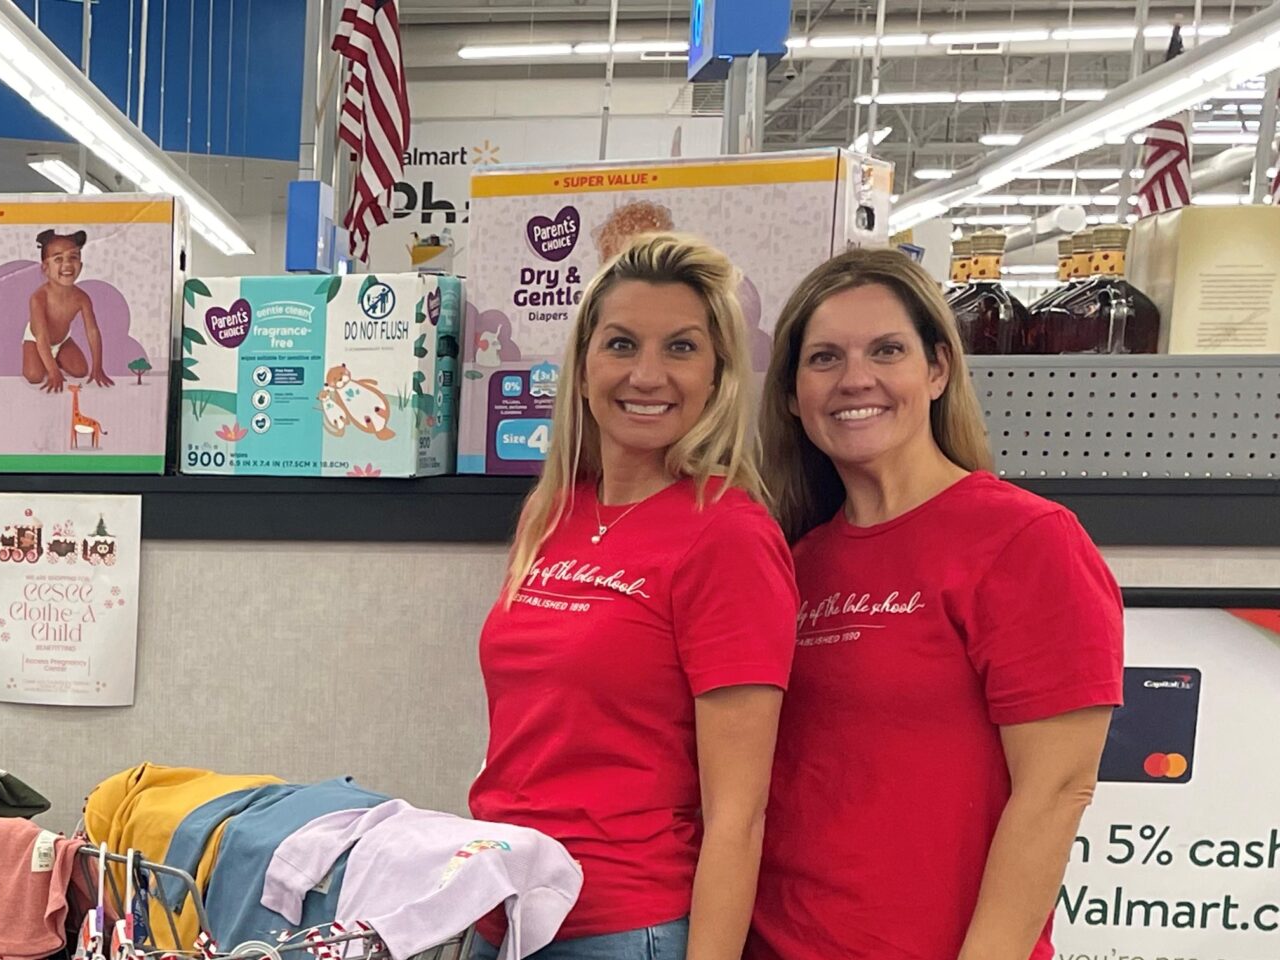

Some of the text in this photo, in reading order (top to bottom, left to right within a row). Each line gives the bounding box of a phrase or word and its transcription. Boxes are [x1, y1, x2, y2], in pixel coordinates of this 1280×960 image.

[403, 147, 467, 165] almart
[563, 172, 649, 188] SUPER VALUE
[533, 217, 577, 242] Parent's
[541, 234, 573, 252] CHOICE
[520, 266, 582, 288] Dry &
[514, 287, 584, 307] Gentle
[211, 309, 249, 330] Parent's
[529, 310, 569, 323] Diapers
[219, 325, 245, 340] CHOICE
[345, 321, 408, 340] DO NOT FLUSH
[271, 338, 294, 348] free
[504, 382, 520, 391] 0%
[502, 425, 551, 454] Size 4
[188, 451, 225, 467] 900
[230, 453, 248, 461] wipes
[31, 622, 82, 642] Child
[1106, 824, 1173, 866] 5%
